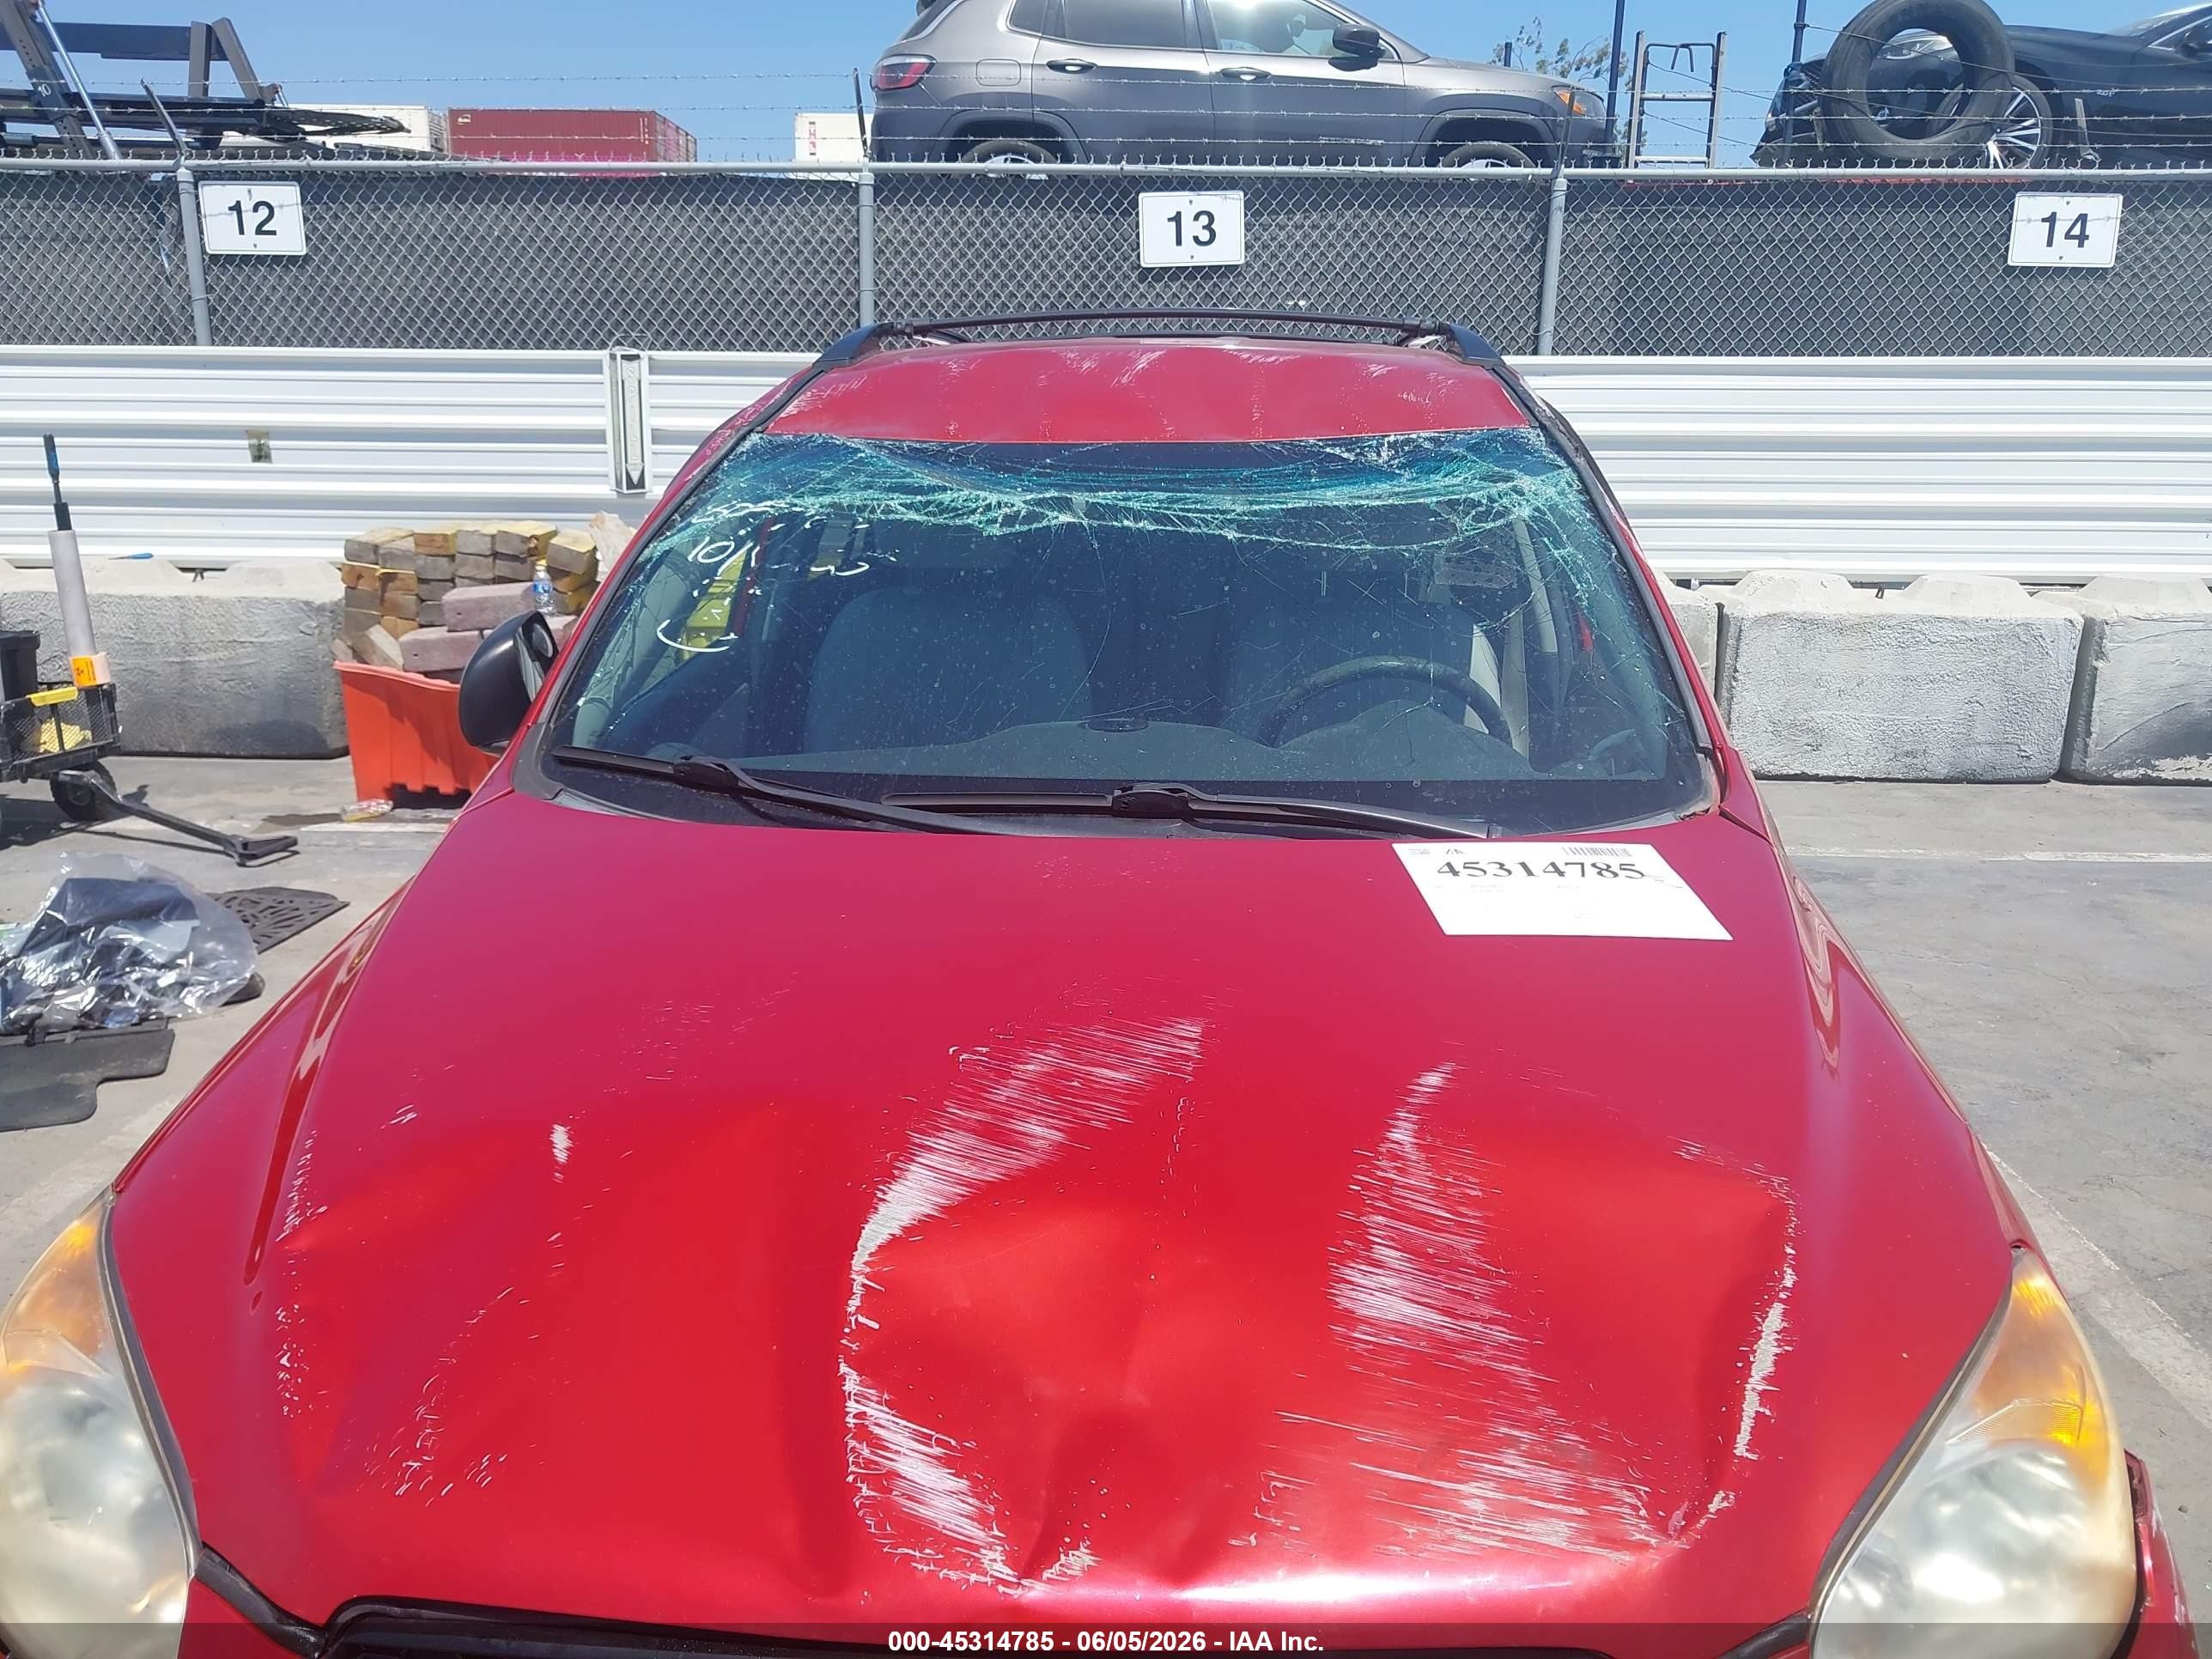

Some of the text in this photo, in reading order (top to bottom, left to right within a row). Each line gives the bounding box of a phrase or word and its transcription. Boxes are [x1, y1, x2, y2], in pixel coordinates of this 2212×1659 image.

[38, 83, 52, 97] 10
[228, 200, 277, 236] 12
[1167, 210, 1217, 246] 13
[2040, 211, 2090, 248] 14
[1437, 861, 1646, 879] 45314785
